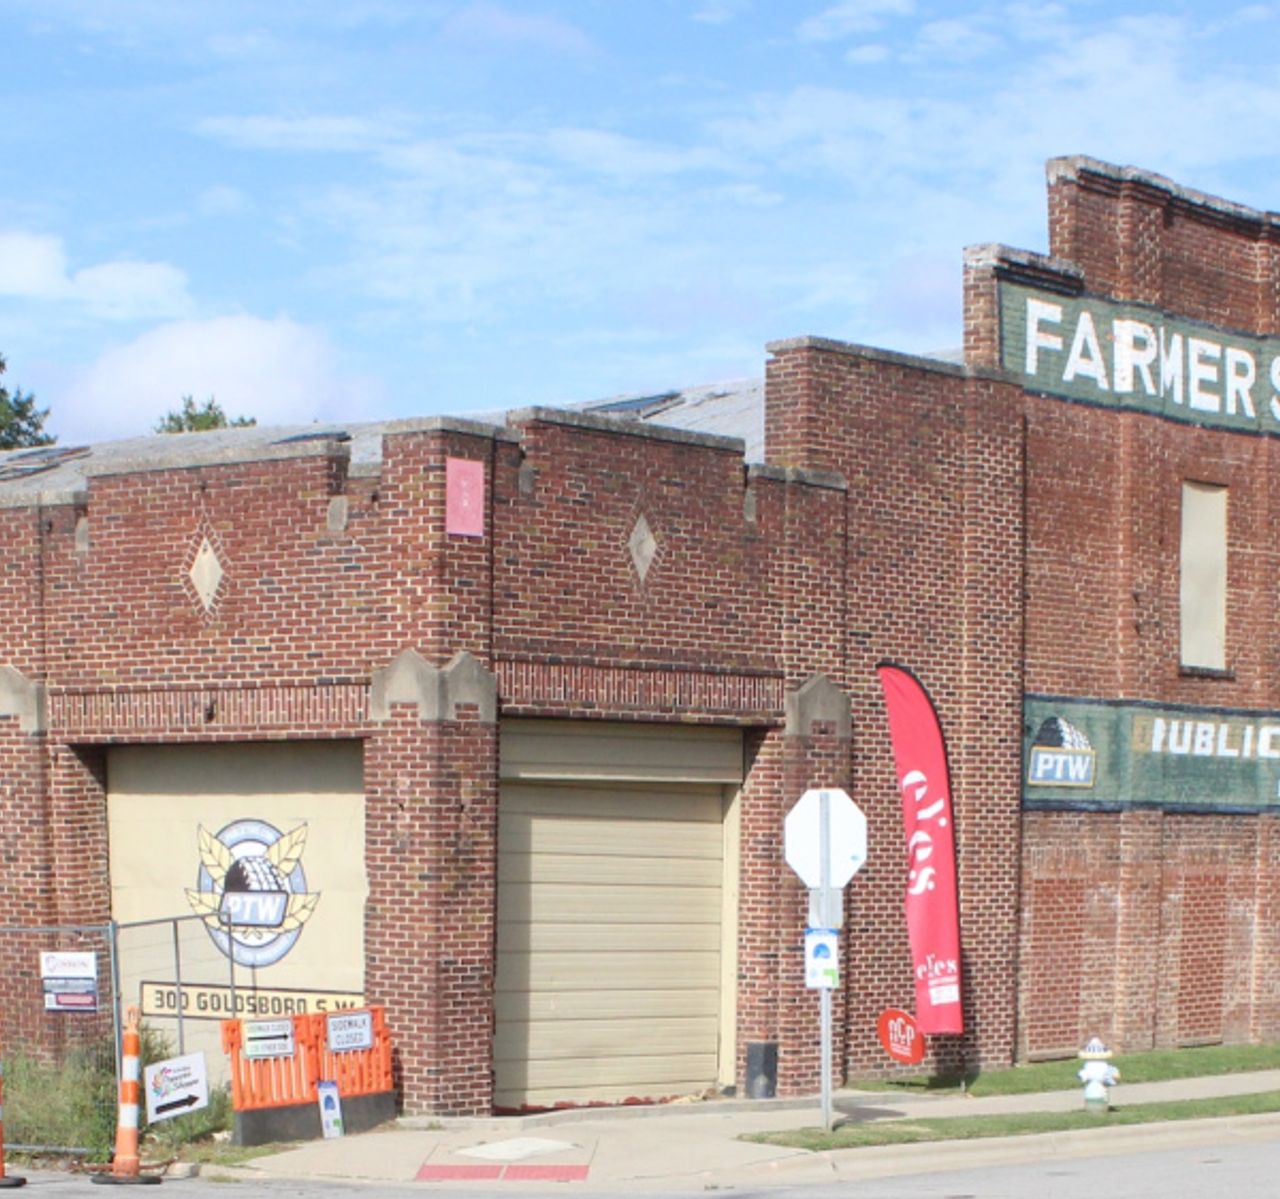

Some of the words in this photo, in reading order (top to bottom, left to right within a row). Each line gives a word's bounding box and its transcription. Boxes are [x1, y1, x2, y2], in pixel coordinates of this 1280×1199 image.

[1036, 752, 1090, 780] PTW
[226, 897, 282, 921] PTW
[154, 989, 190, 1010] 300
[331, 1018, 366, 1032] SIDEWALK
